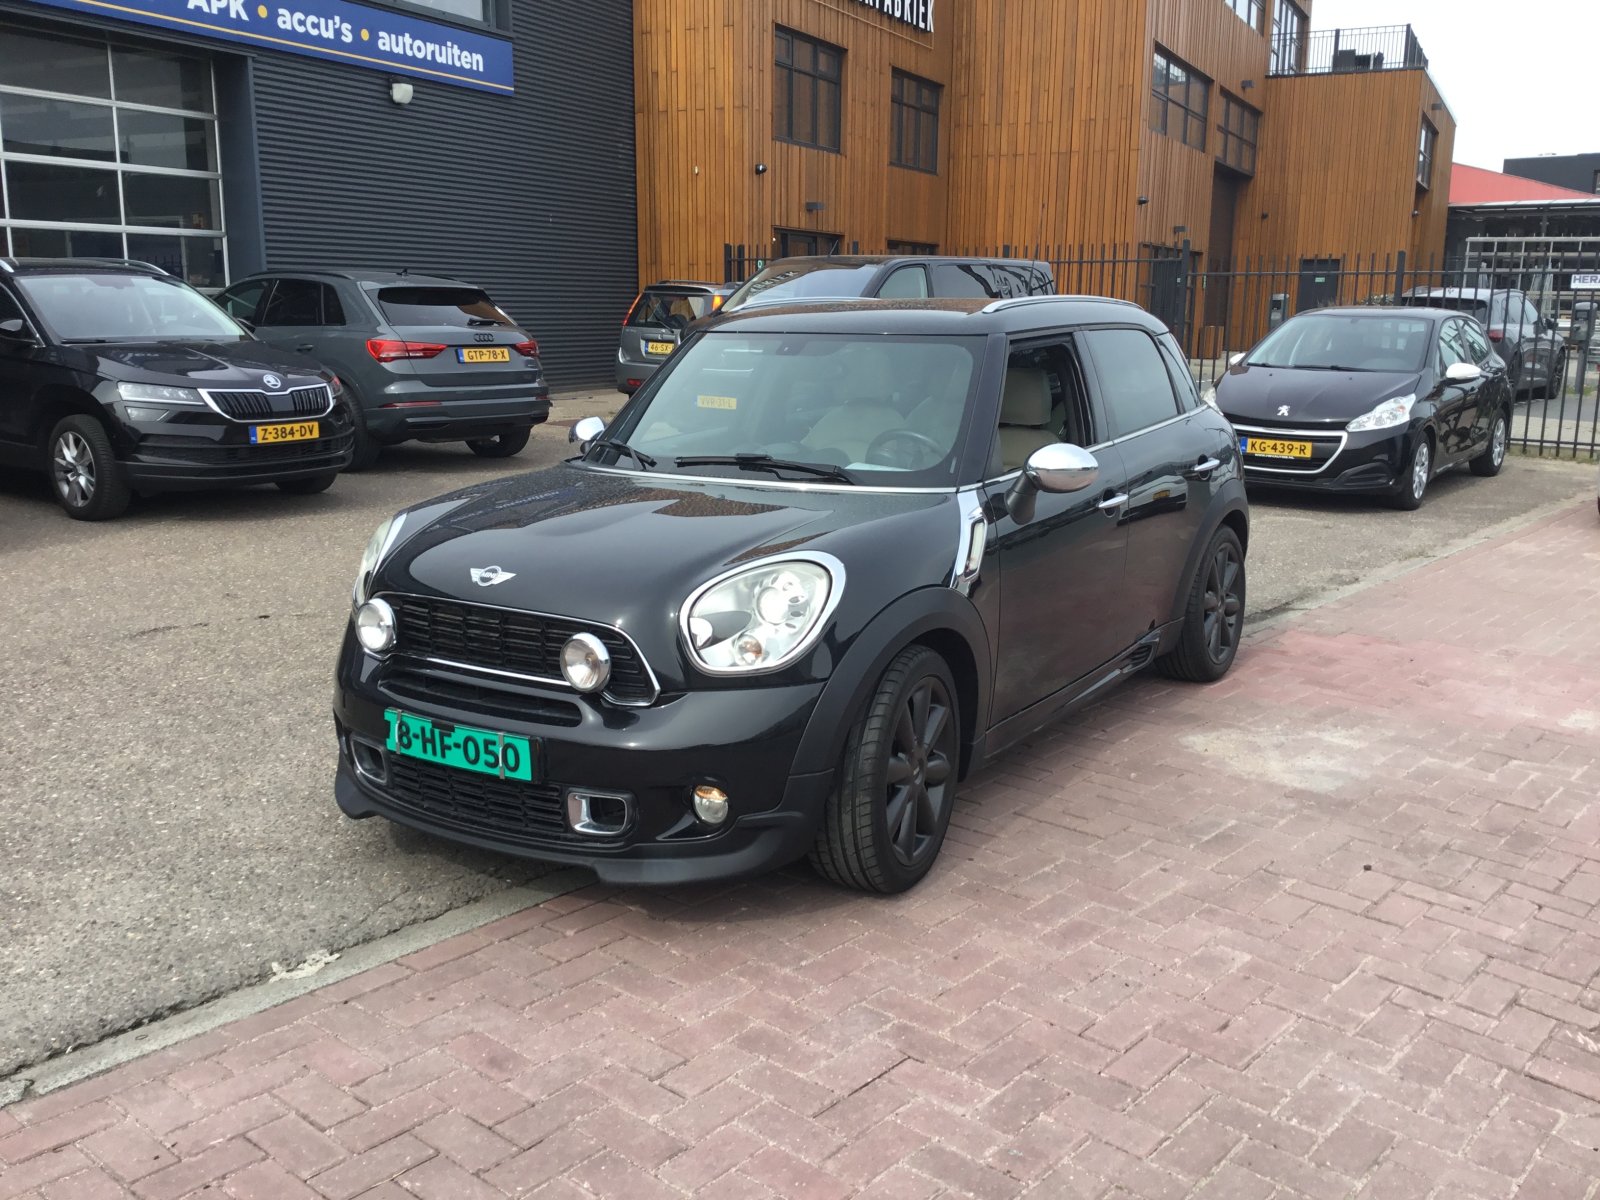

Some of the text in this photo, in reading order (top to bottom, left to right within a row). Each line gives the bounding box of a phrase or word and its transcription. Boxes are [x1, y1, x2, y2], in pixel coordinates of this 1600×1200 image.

[277, 8, 353, 43] accu's
[378, 31, 483, 72] autoruiten
[467, 350, 506, 360] GTP-78-X
[261, 424, 314, 441] Z-384-DV
[1250, 440, 1307, 455] KG-439-R
